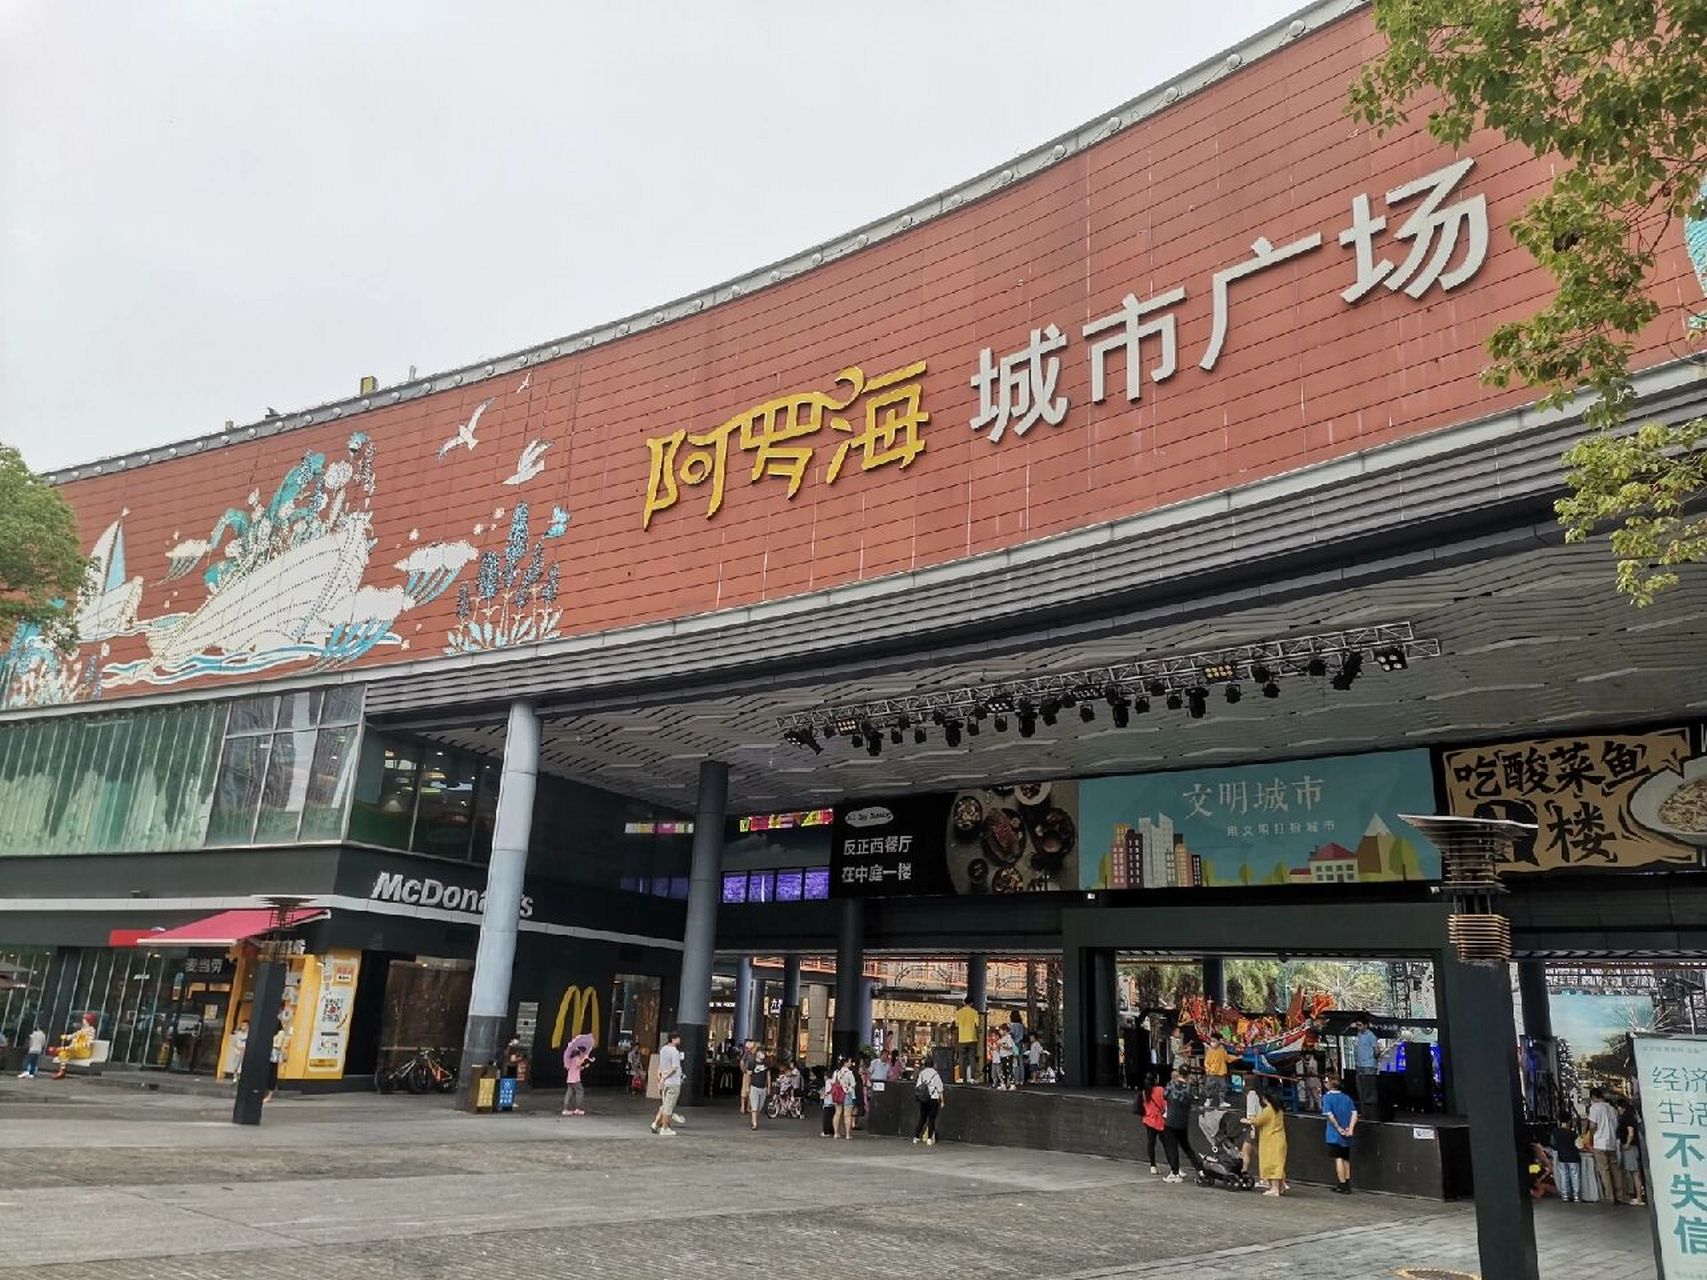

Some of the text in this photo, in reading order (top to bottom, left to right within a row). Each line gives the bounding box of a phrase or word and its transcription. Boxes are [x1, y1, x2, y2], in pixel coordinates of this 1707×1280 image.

[643, 157, 1488, 531] 阿罗海 城市广场
[1454, 741, 1650, 798] 吃酸菜鱼
[1182, 775, 1324, 820] 文明城市
[843, 836, 913, 855] 反正西餐厅
[842, 862, 911, 883] 在中庭一楼
[184, 958, 223, 974] 麦当劳
